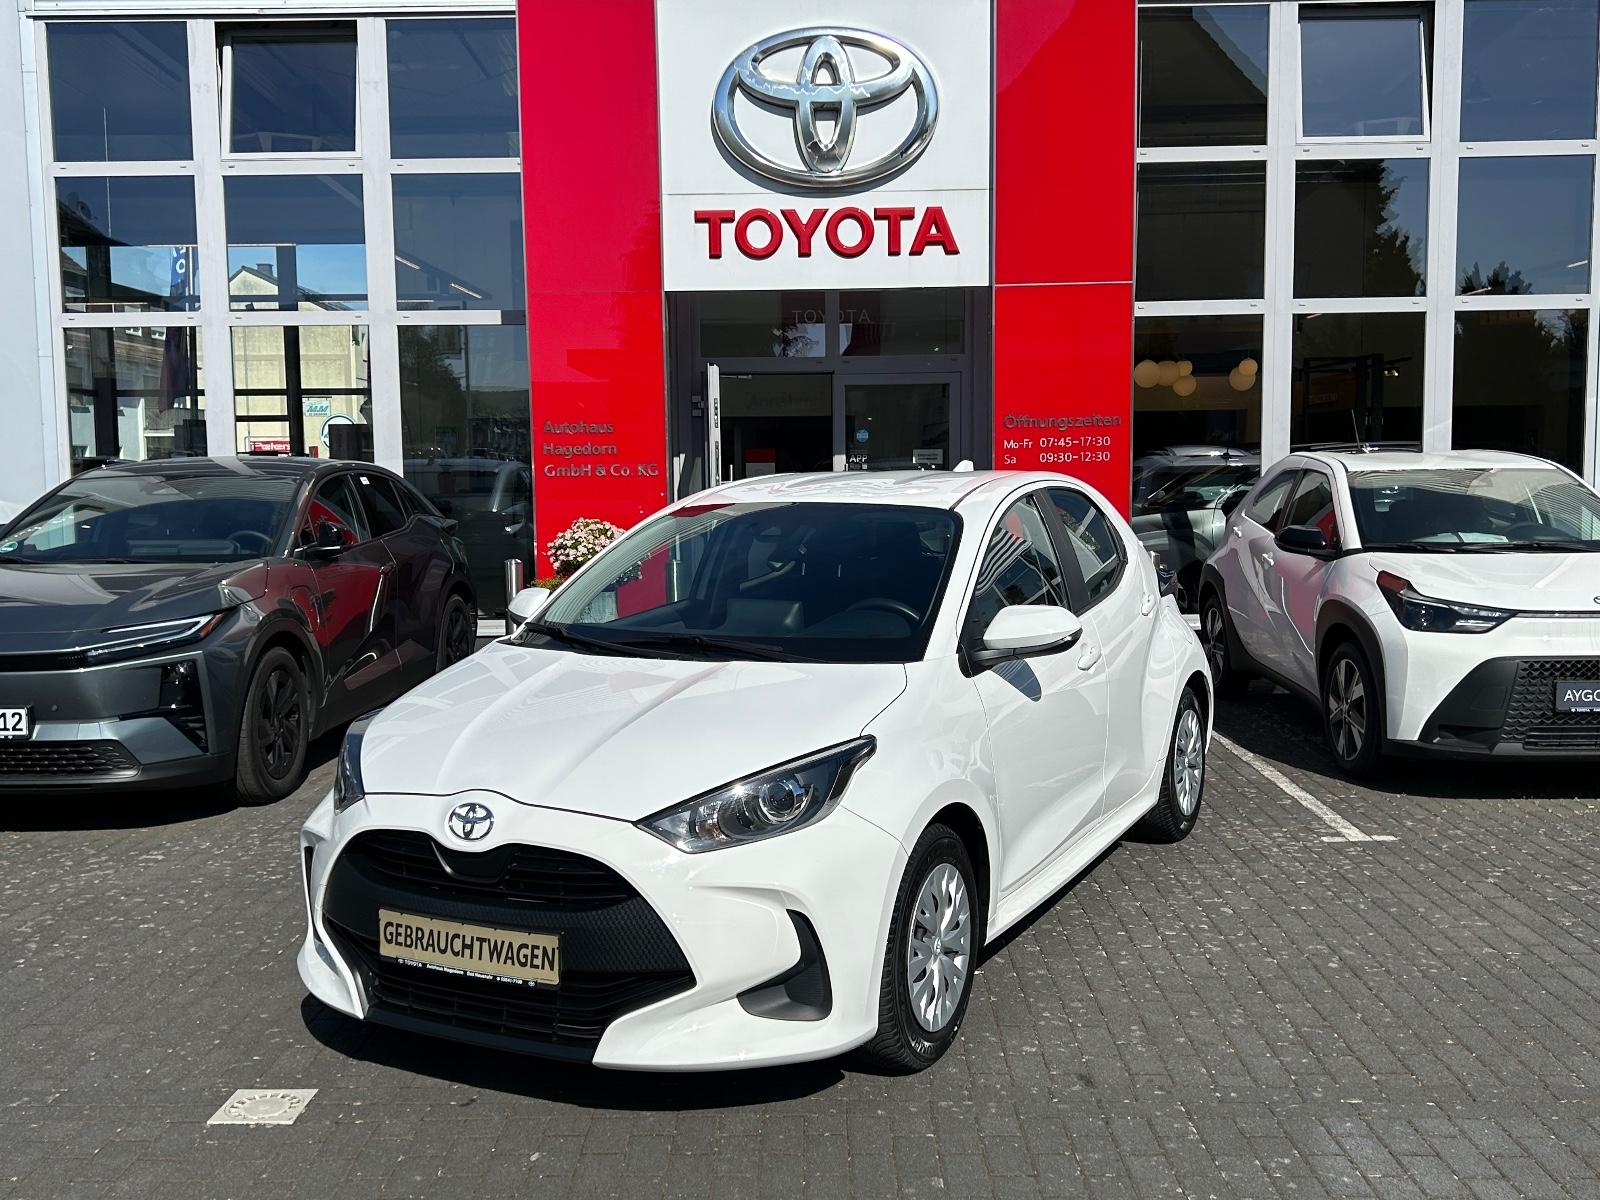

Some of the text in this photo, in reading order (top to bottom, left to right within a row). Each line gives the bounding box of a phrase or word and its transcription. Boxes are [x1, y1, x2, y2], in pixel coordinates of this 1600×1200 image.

[694, 206, 960, 260] TOYOTA
[543, 420, 614, 434] Autohaus
[1004, 413, 1121, 431] Öffnungszeiten
[543, 442, 618, 459] Hagedorn
[1003, 438, 1033, 449] Mo-Fr
[849, 454, 868, 463] APP
[1004, 454, 1017, 465] Sa
[544, 463, 592, 477] GmbH
[595, 464, 606, 476] &
[637, 463, 659, 477] KG
[0, 712, 24, 732] 12
[383, 921, 556, 971] GEBRAUCHTWAGEN
